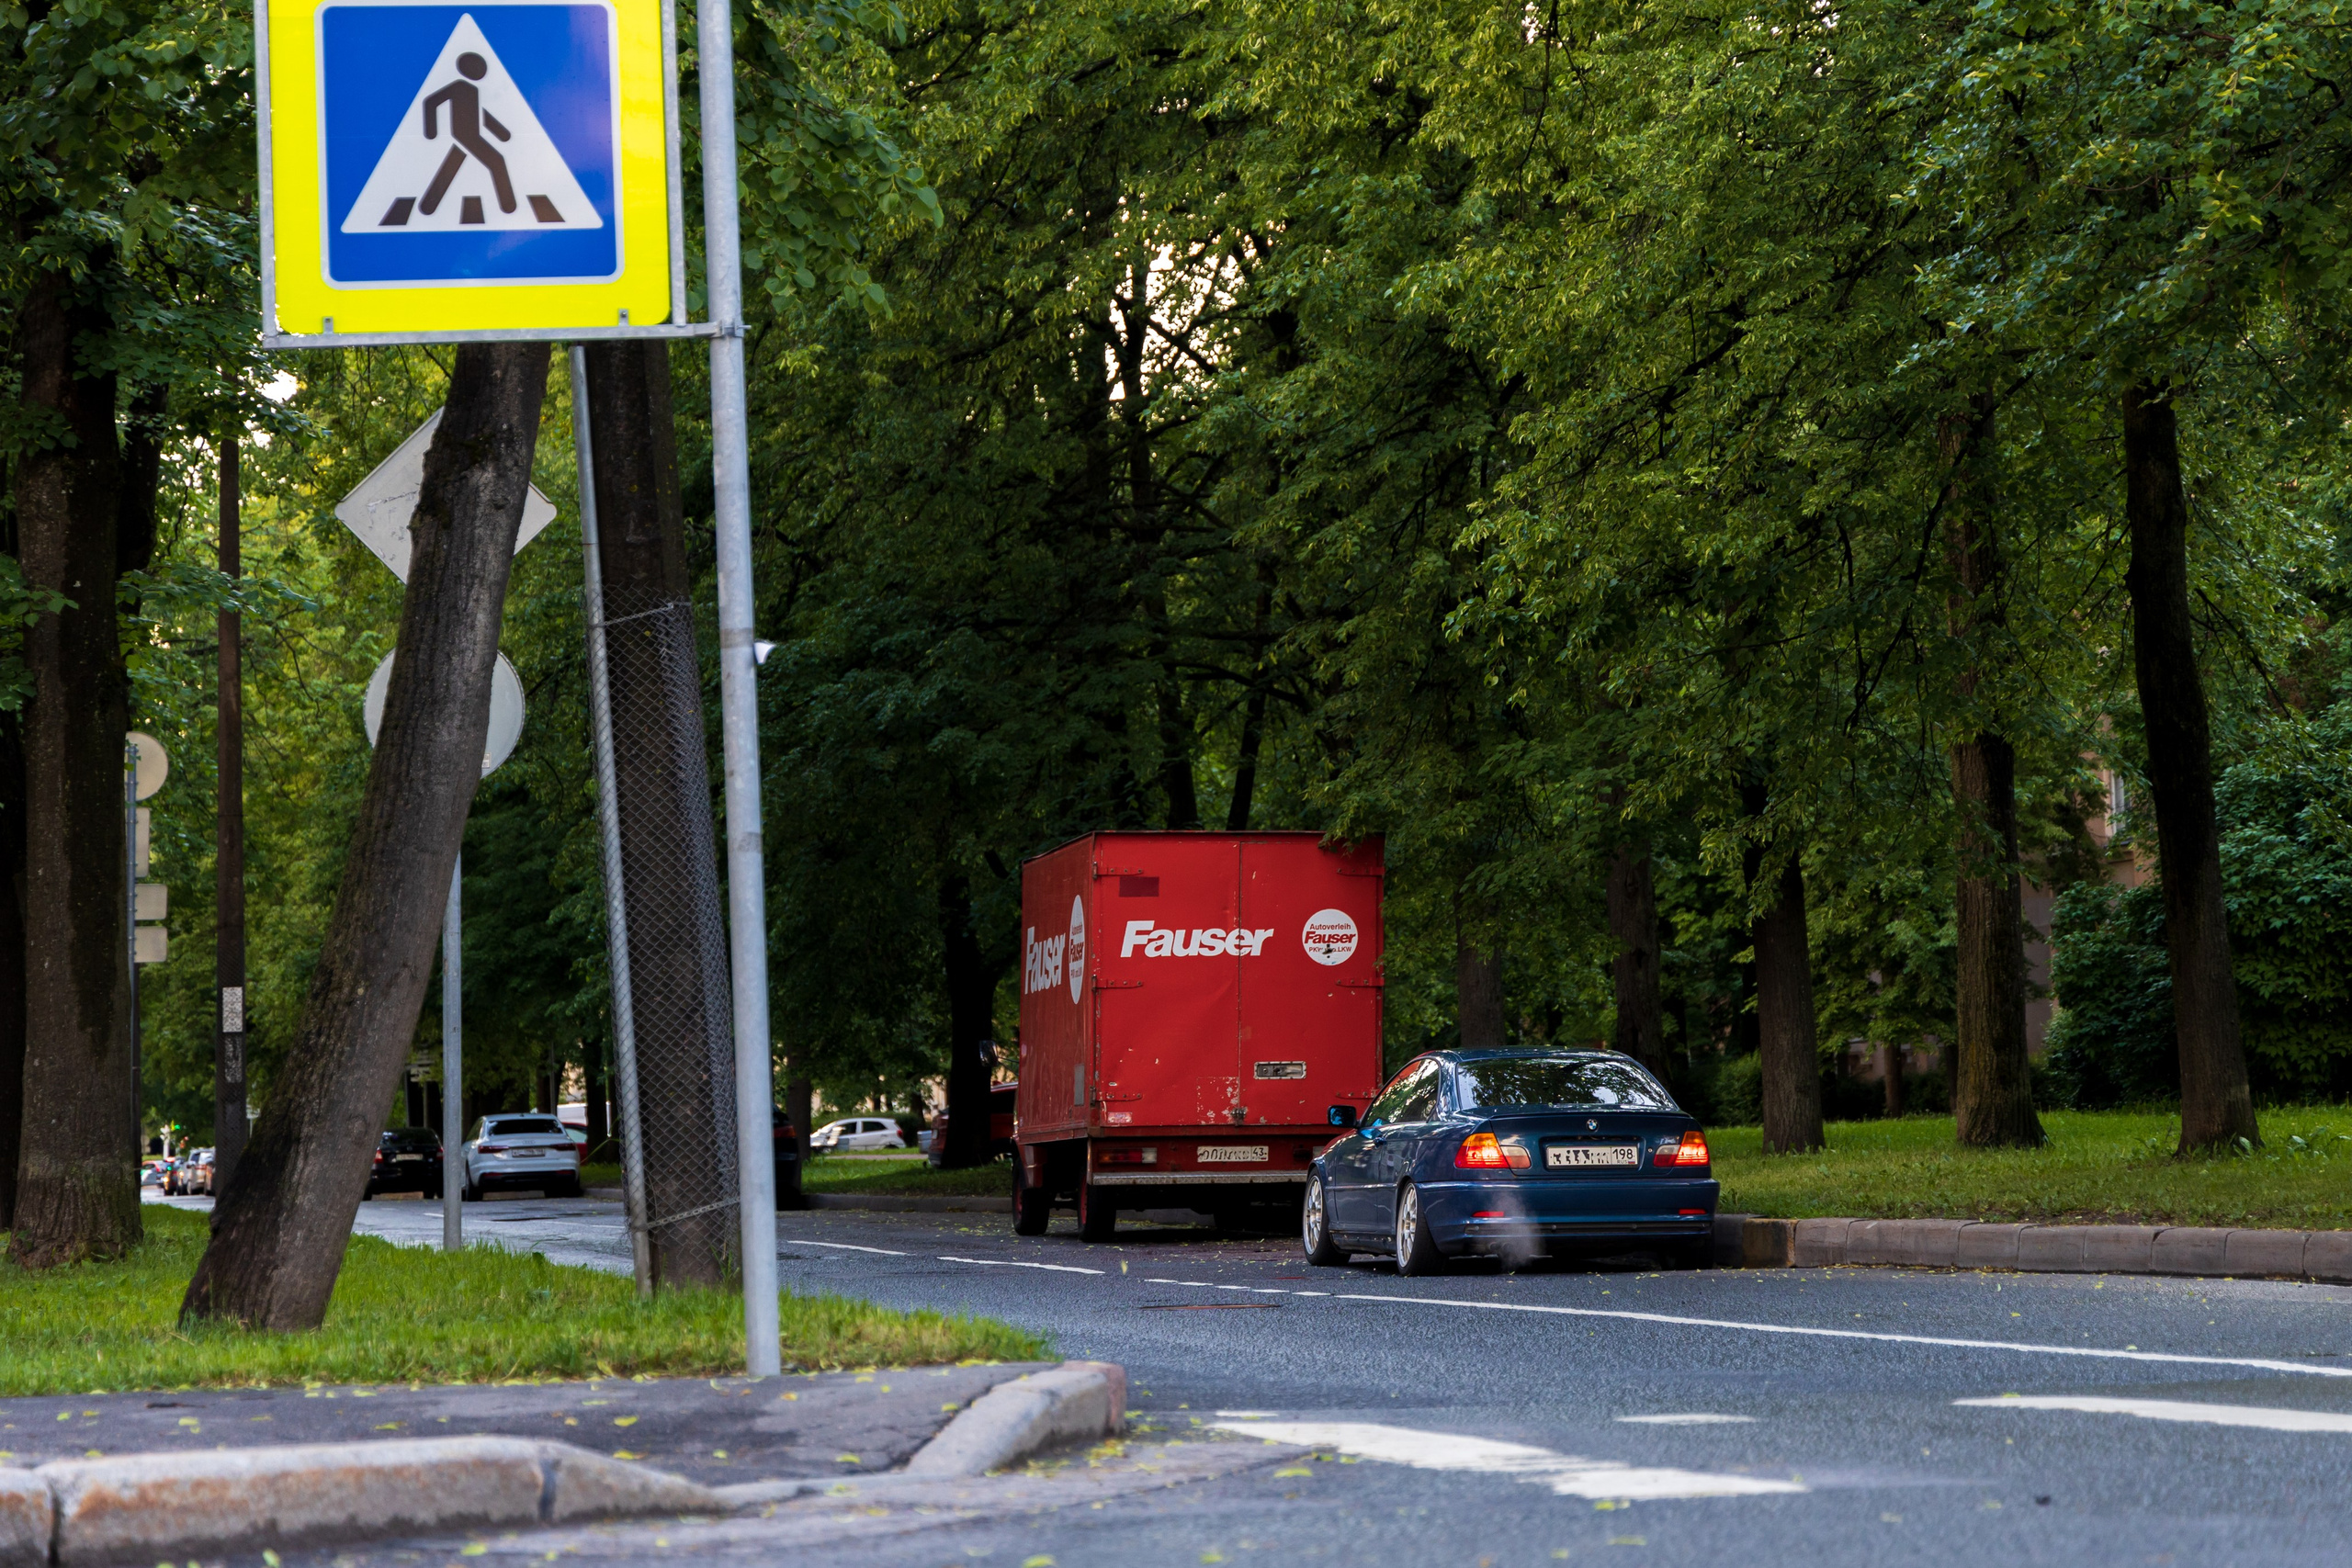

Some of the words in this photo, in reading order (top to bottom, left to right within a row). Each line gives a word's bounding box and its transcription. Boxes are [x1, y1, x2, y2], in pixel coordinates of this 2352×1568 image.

[1120, 920, 1274, 958] Fauser
[1304, 931, 1356, 944] Fauser
[1024, 926, 1066, 995] Fauser
[1252, 1147, 1264, 1156] 43
[1612, 1148, 1634, 1159] 198
